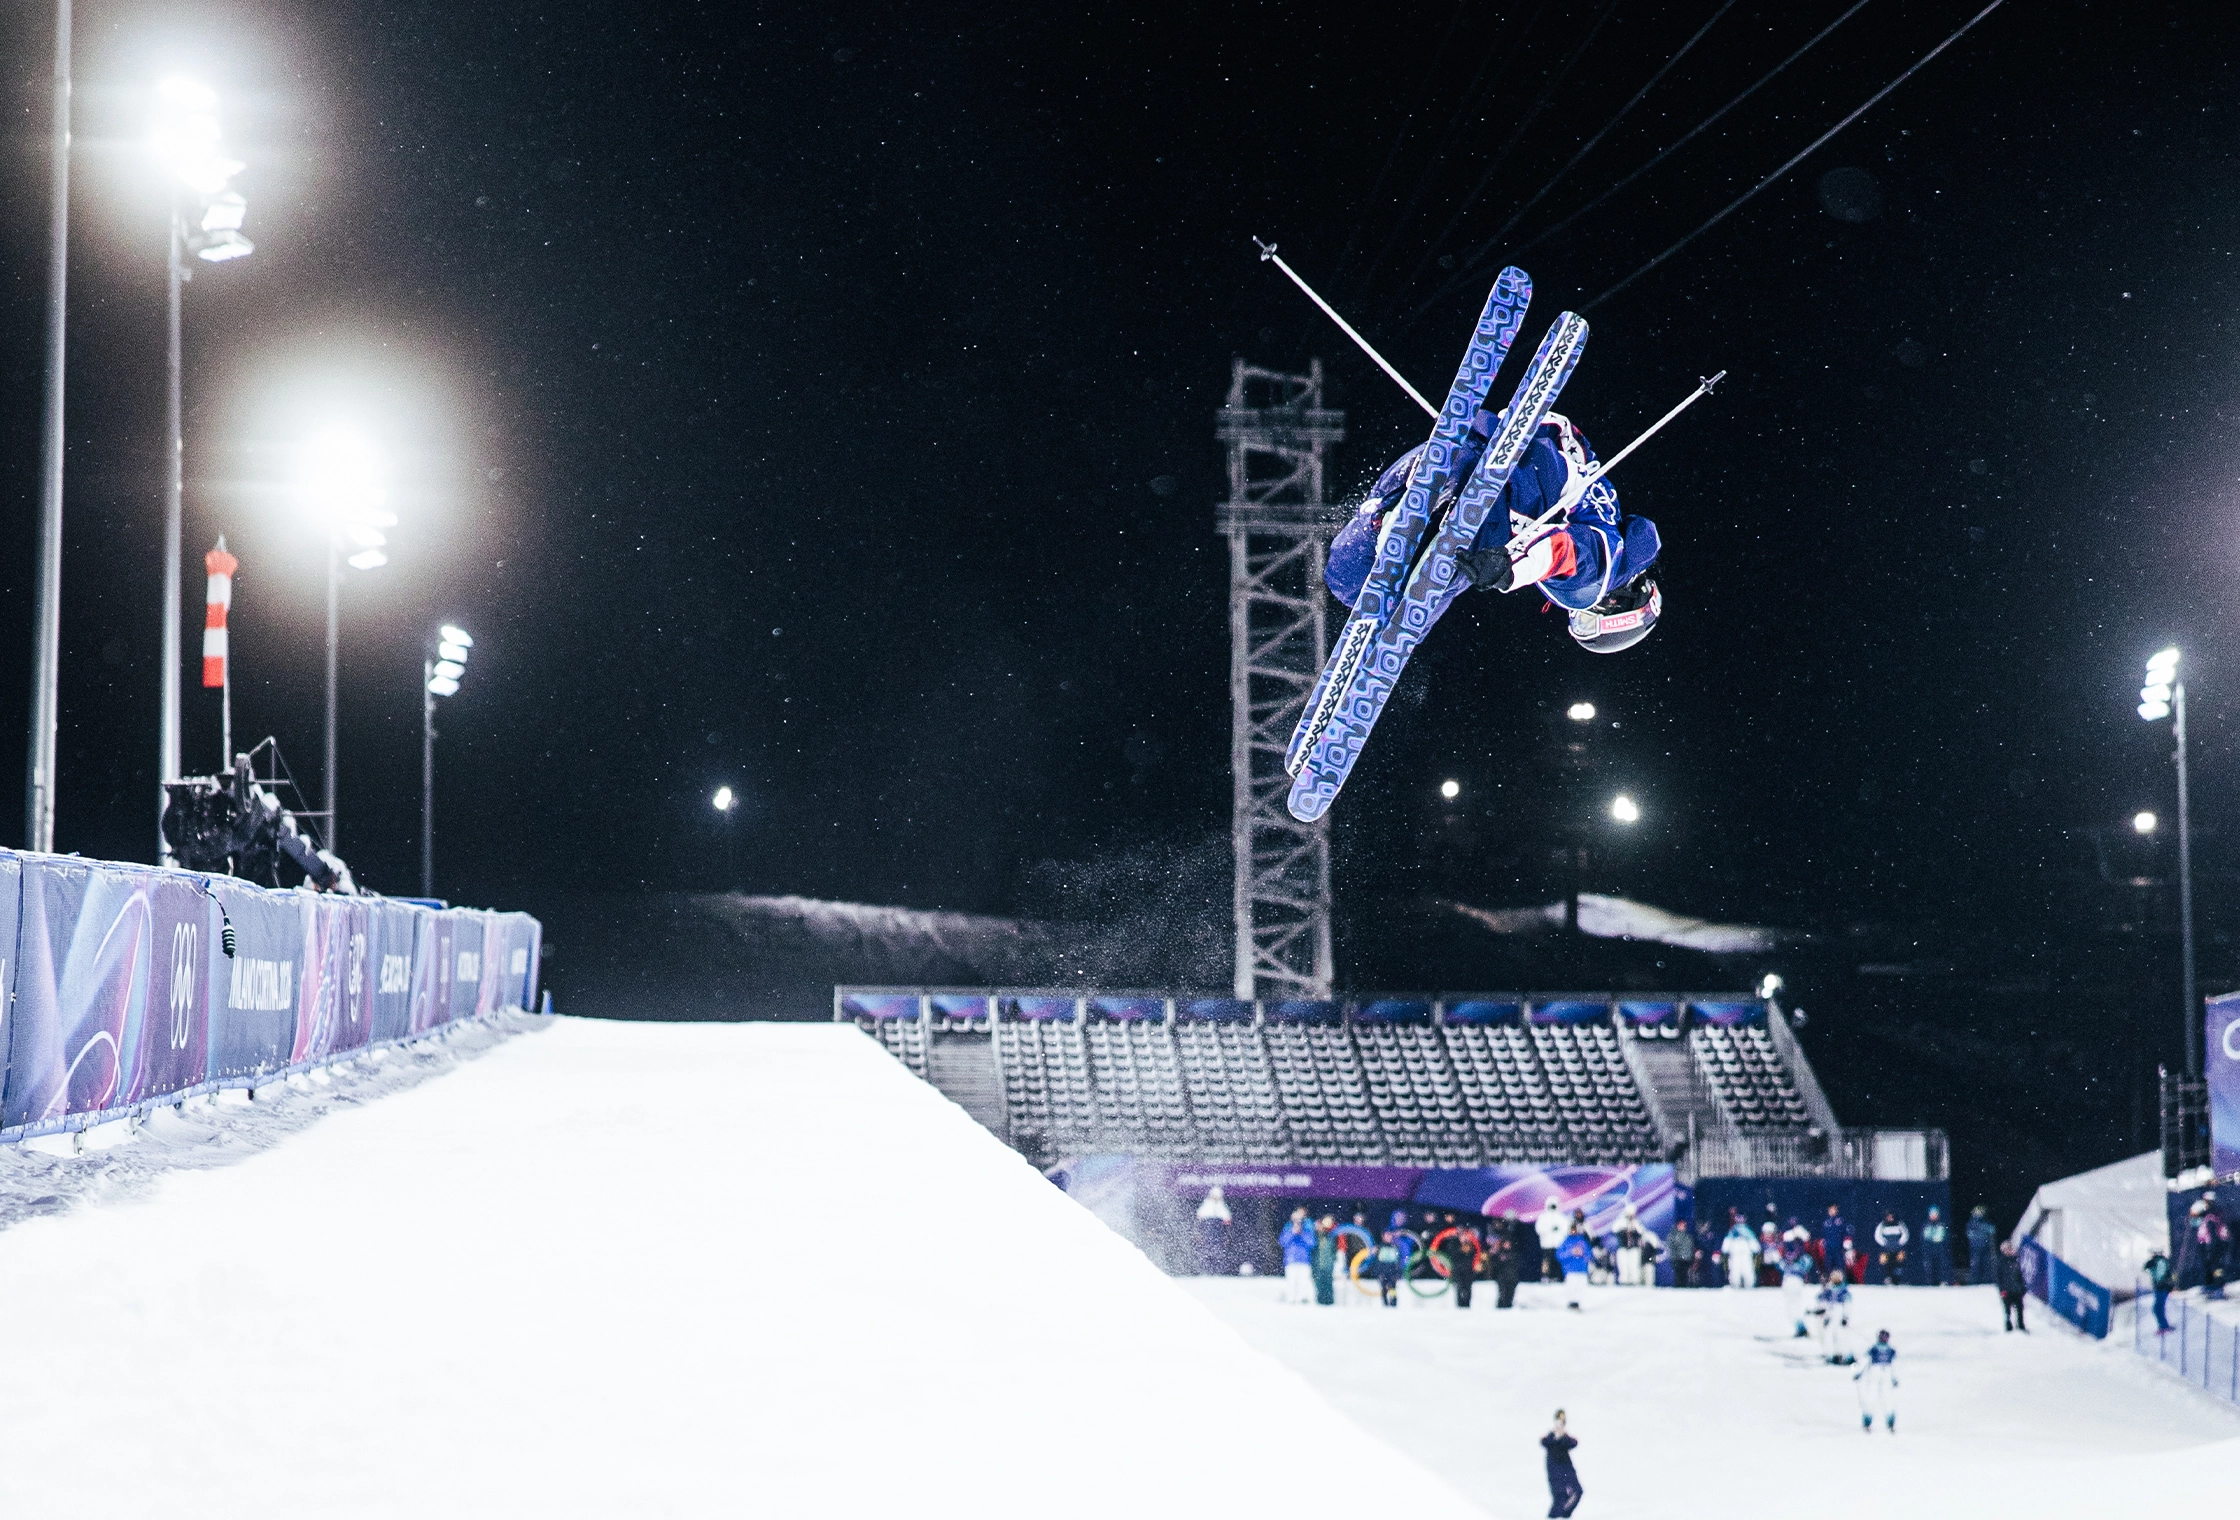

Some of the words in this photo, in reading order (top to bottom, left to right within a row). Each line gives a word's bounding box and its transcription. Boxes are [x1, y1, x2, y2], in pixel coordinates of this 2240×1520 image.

[1565, 322, 1579, 333] K2
[1559, 332, 1574, 343] K2
[1552, 344, 1568, 355] K2
[1546, 355, 1562, 366] K2
[1539, 367, 1556, 379] K2
[1532, 379, 1549, 391] K2
[1525, 391, 1542, 403] K2
[1518, 403, 1535, 415] K2
[1511, 416, 1528, 427] K2
[1504, 428, 1521, 440] K2
[1497, 441, 1515, 452] K2
[1490, 453, 1508, 465] K2
[1605, 616, 1636, 628] SMITH
